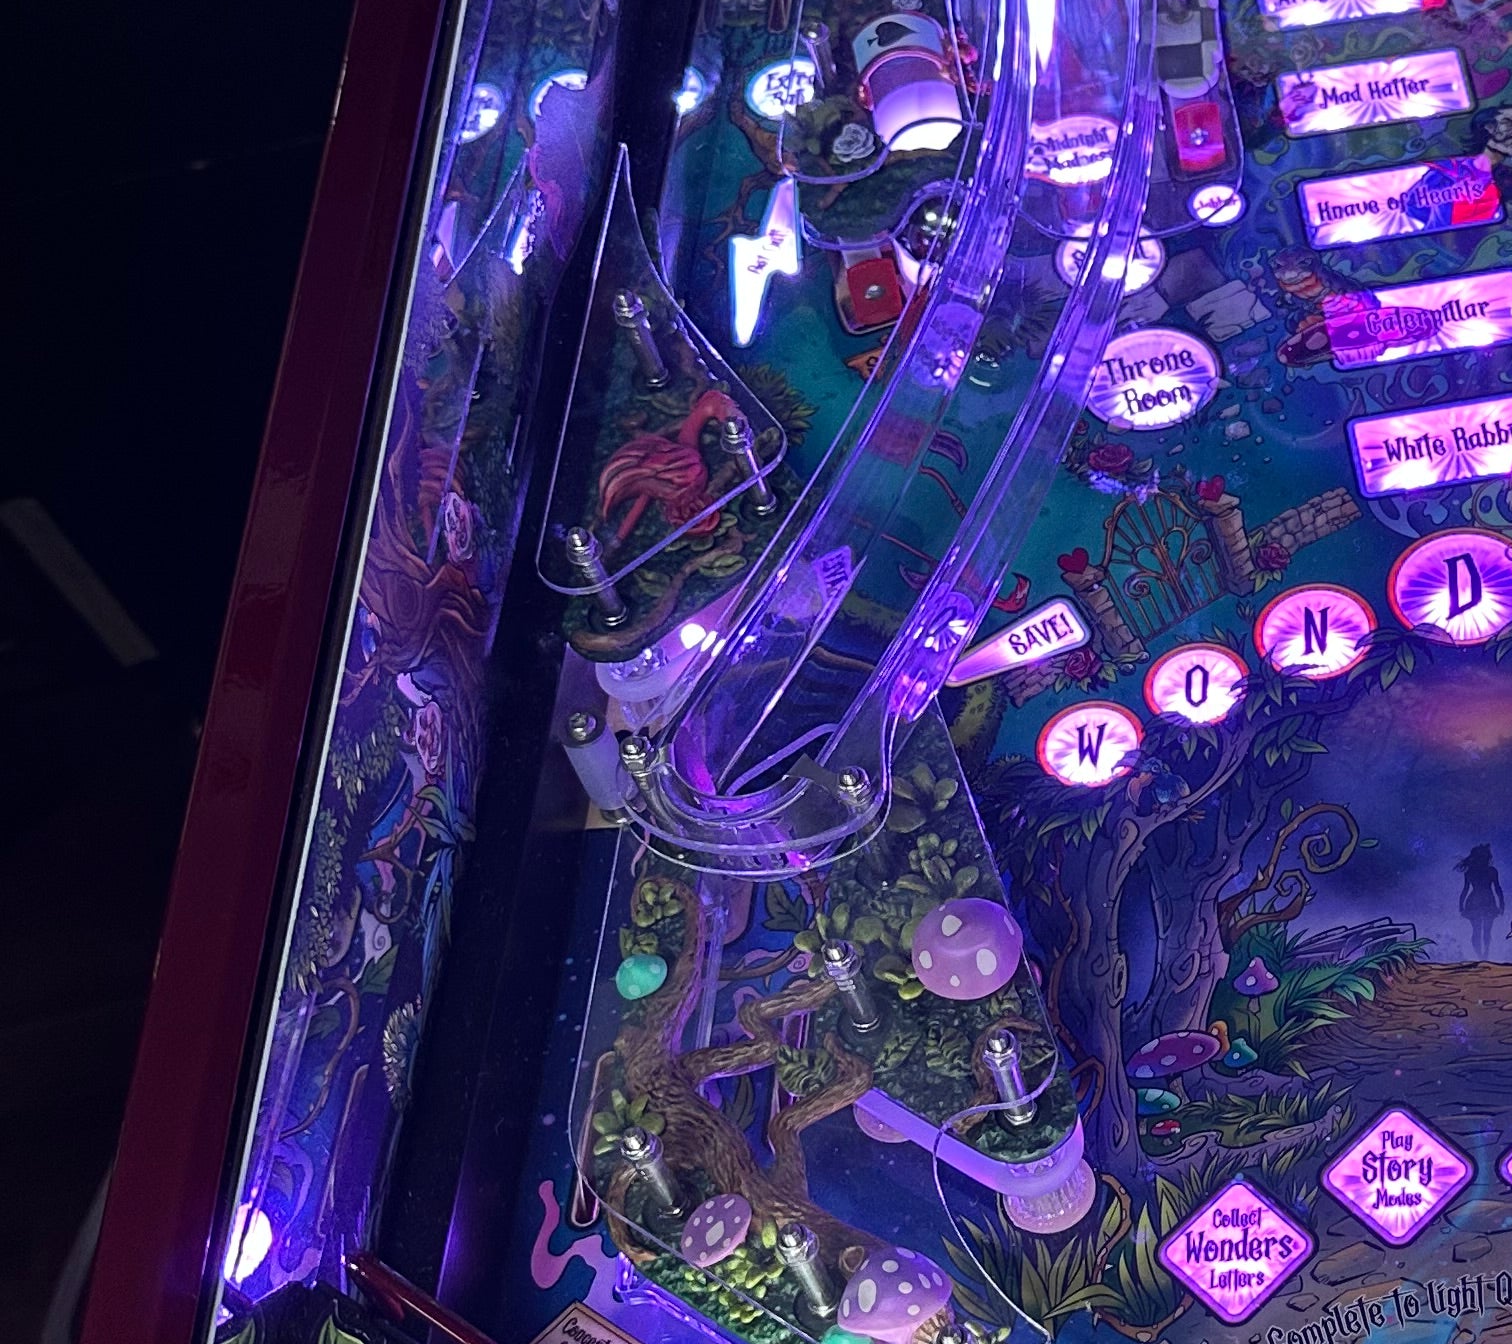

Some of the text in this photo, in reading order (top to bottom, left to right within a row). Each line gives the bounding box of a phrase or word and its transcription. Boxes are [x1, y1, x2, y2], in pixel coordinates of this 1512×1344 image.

[1319, 77, 1430, 110] Mad Hatter
[1317, 180, 1485, 223] Knave of Hearts
[1364, 299, 1492, 338] Caterpillar
[1102, 347, 1196, 387] Throne
[1122, 382, 1193, 417] Room
[1383, 433, 1447, 463] White
[1008, 612, 1075, 655] SAVE!
[1077, 722, 1108, 762] W
[1186, 665, 1208, 708] O
[1304, 605, 1330, 656] N
[1448, 551, 1483, 621] D
[1382, 1130, 1413, 1152] Play
[1362, 1151, 1433, 1185] Story
[1372, 1188, 1422, 1209] Modes
[1212, 1208, 1264, 1229] Collect
[1185, 1227, 1294, 1264] Wonders
[1210, 1268, 1265, 1292] Letters
[1381, 1288, 1420, 1329] to
[1426, 1273, 1490, 1317] light
